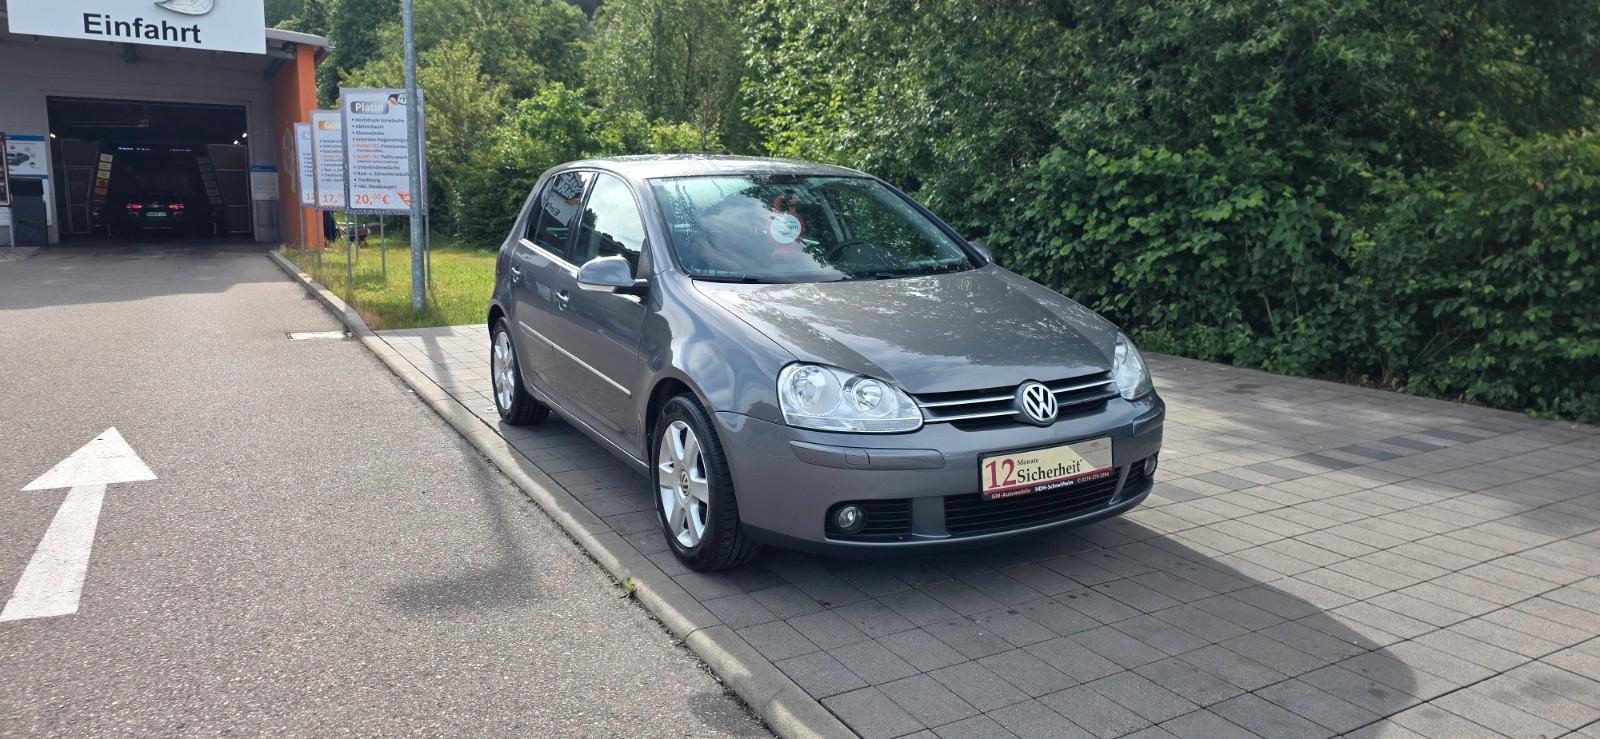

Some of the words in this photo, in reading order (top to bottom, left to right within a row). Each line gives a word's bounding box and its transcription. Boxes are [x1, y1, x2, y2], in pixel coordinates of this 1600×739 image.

[83, 12, 202, 43] Einfahrt
[985, 458, 1017, 489] 12
[1017, 457, 1039, 466] Monate
